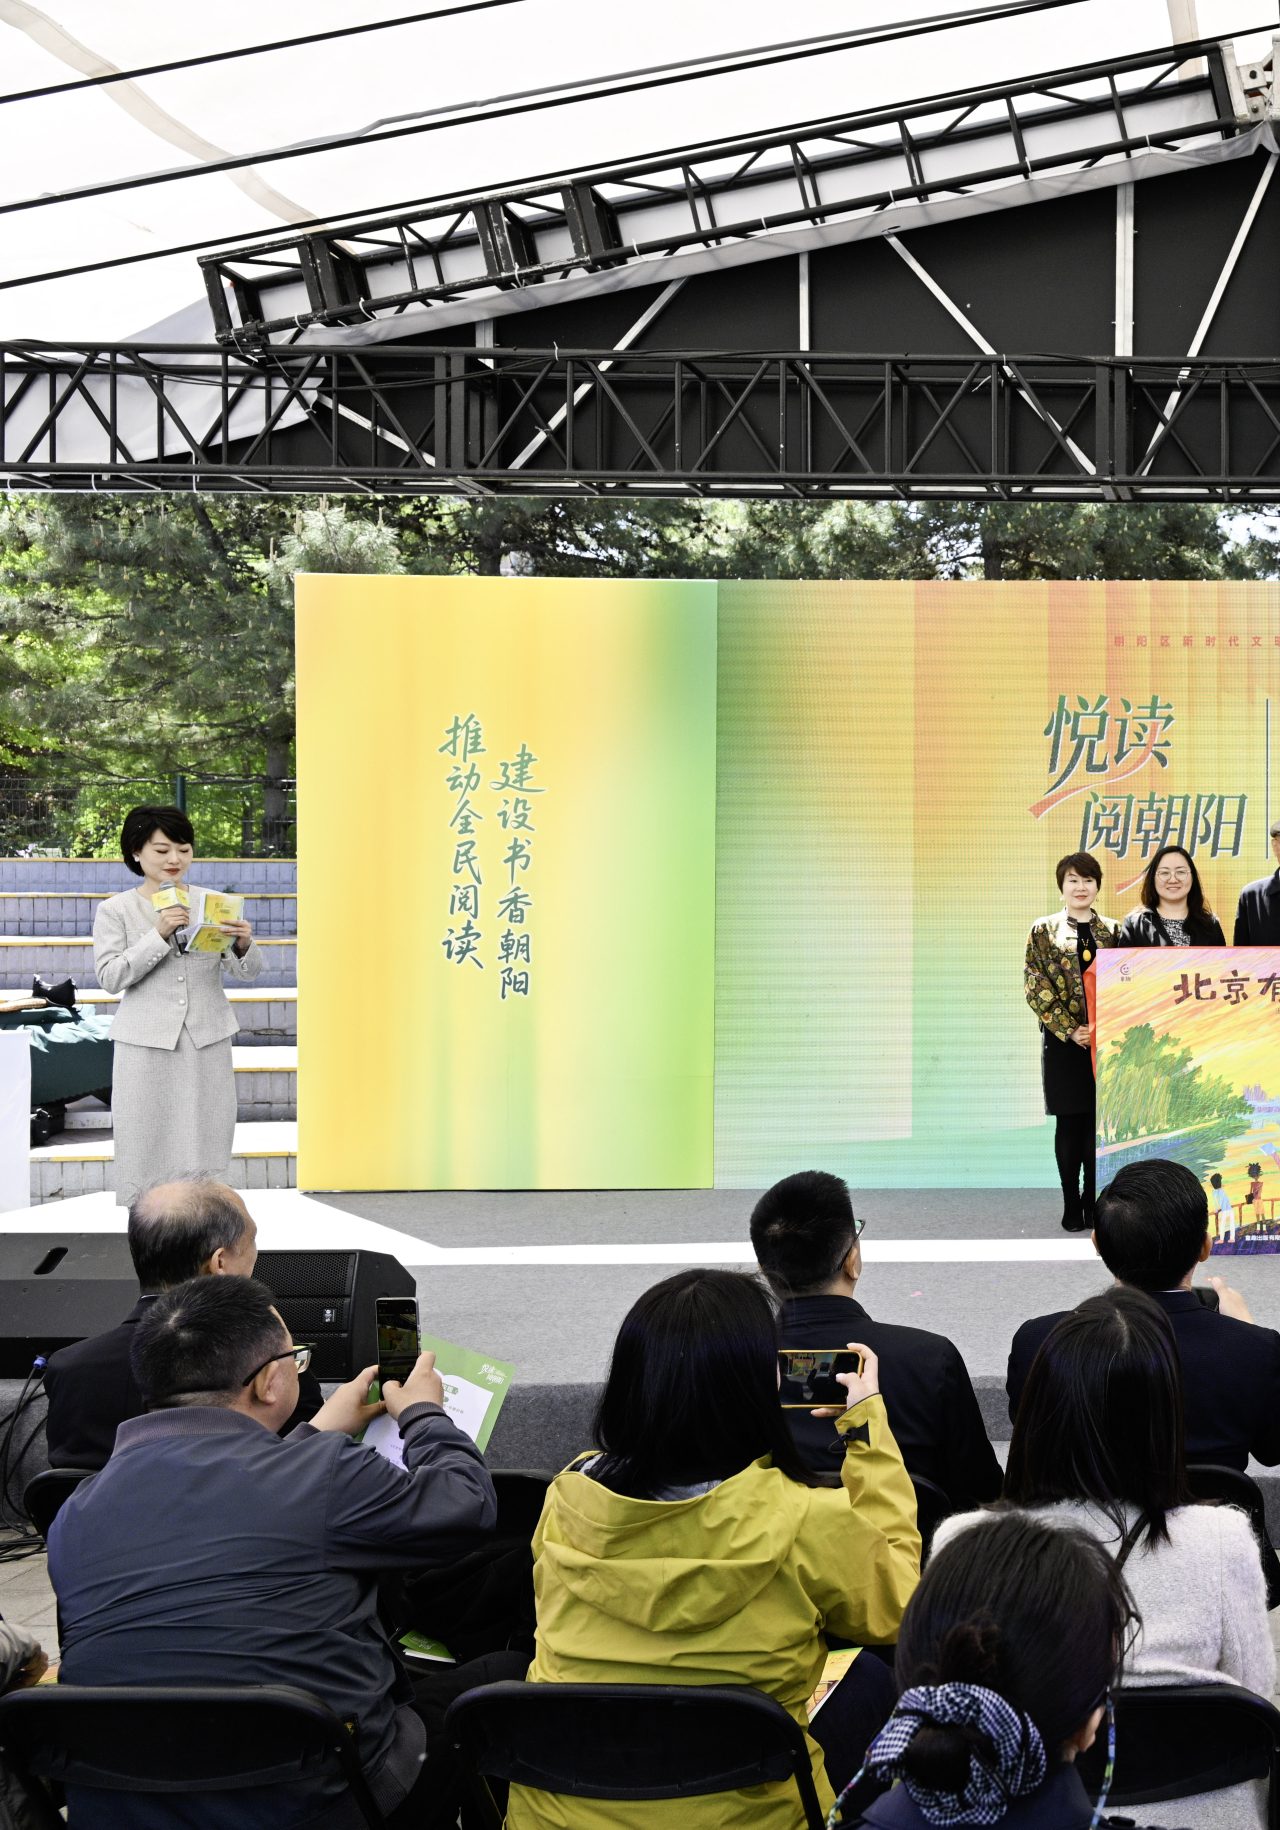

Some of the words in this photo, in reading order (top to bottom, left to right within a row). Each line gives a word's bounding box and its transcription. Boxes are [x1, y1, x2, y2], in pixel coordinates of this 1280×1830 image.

[438, 712, 487, 969] 推动全民阅读
[1028, 694, 1175, 819] 悦读
[1079, 791, 1248, 890] 阅朝阳
[489, 743, 547, 1000] 建设书香朝阳
